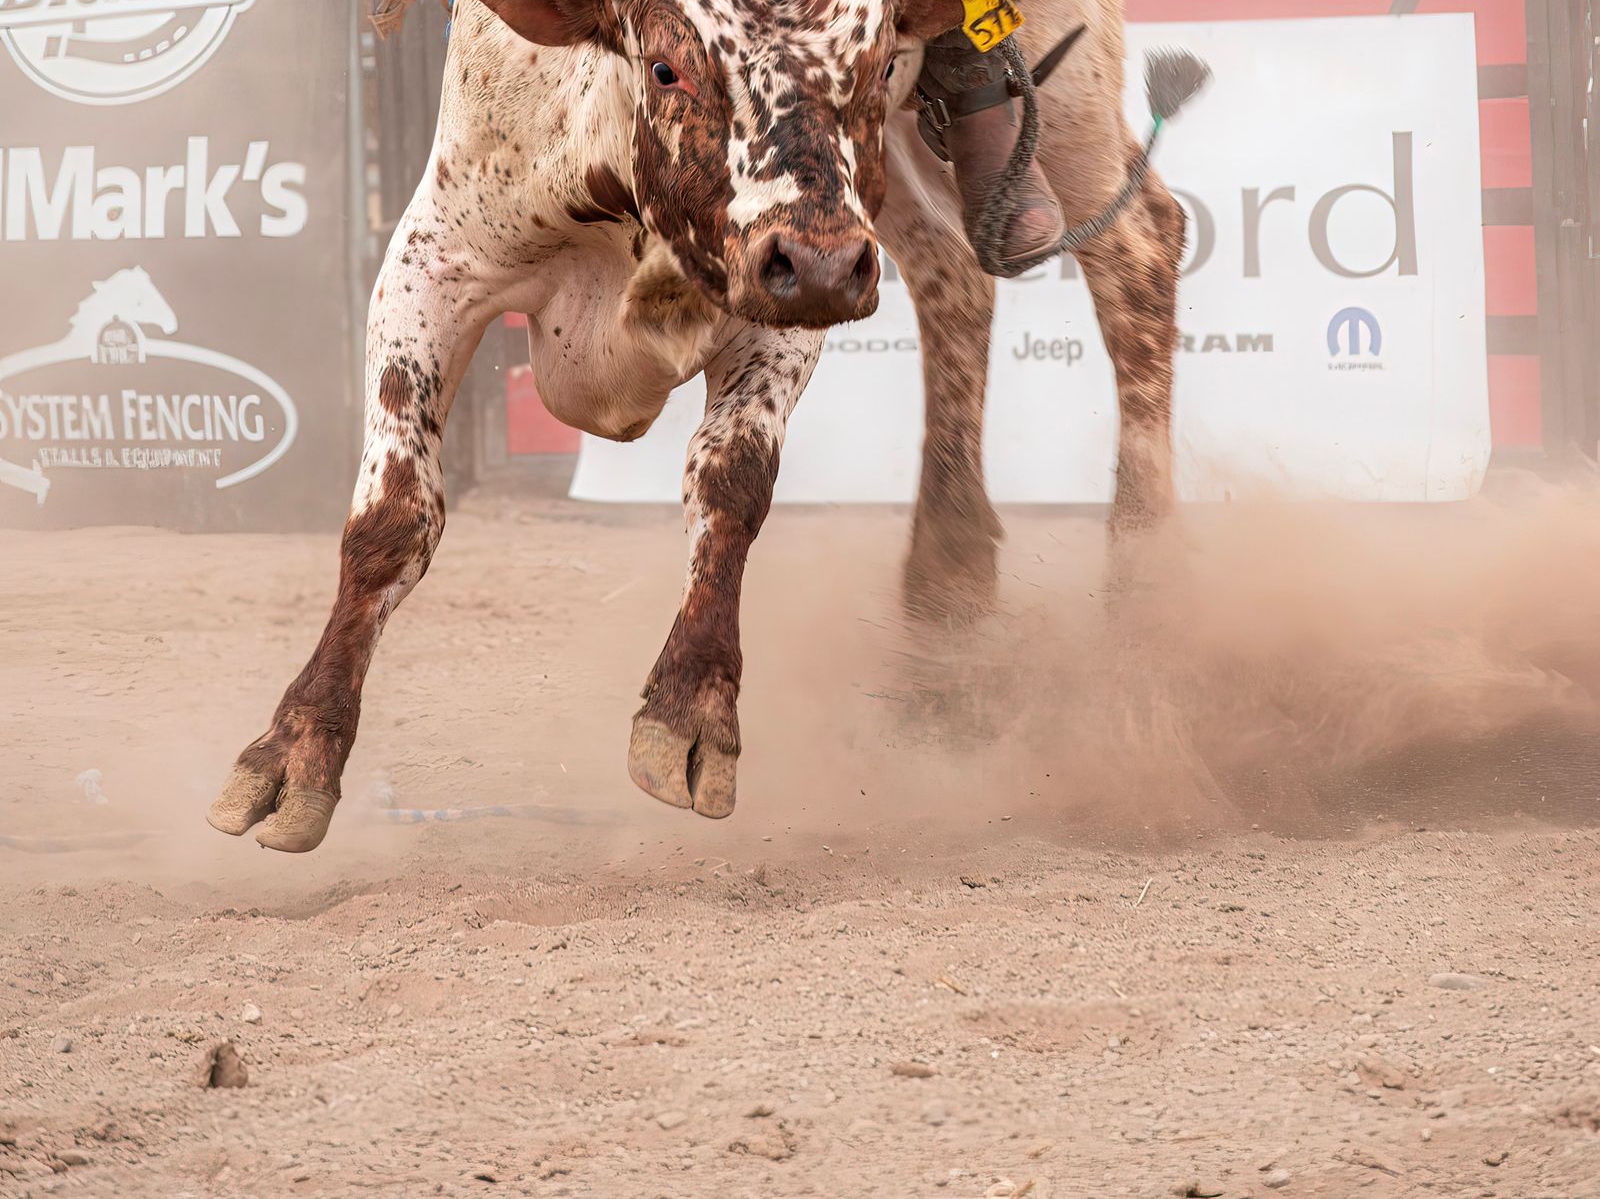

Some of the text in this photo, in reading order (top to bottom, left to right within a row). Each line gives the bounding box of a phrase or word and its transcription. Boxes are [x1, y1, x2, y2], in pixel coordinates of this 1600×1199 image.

[6, 137, 308, 240] Mark's
[824, 338, 918, 352] ODG
[1013, 331, 1084, 366] Jeep
[121, 389, 265, 442] FENCING
